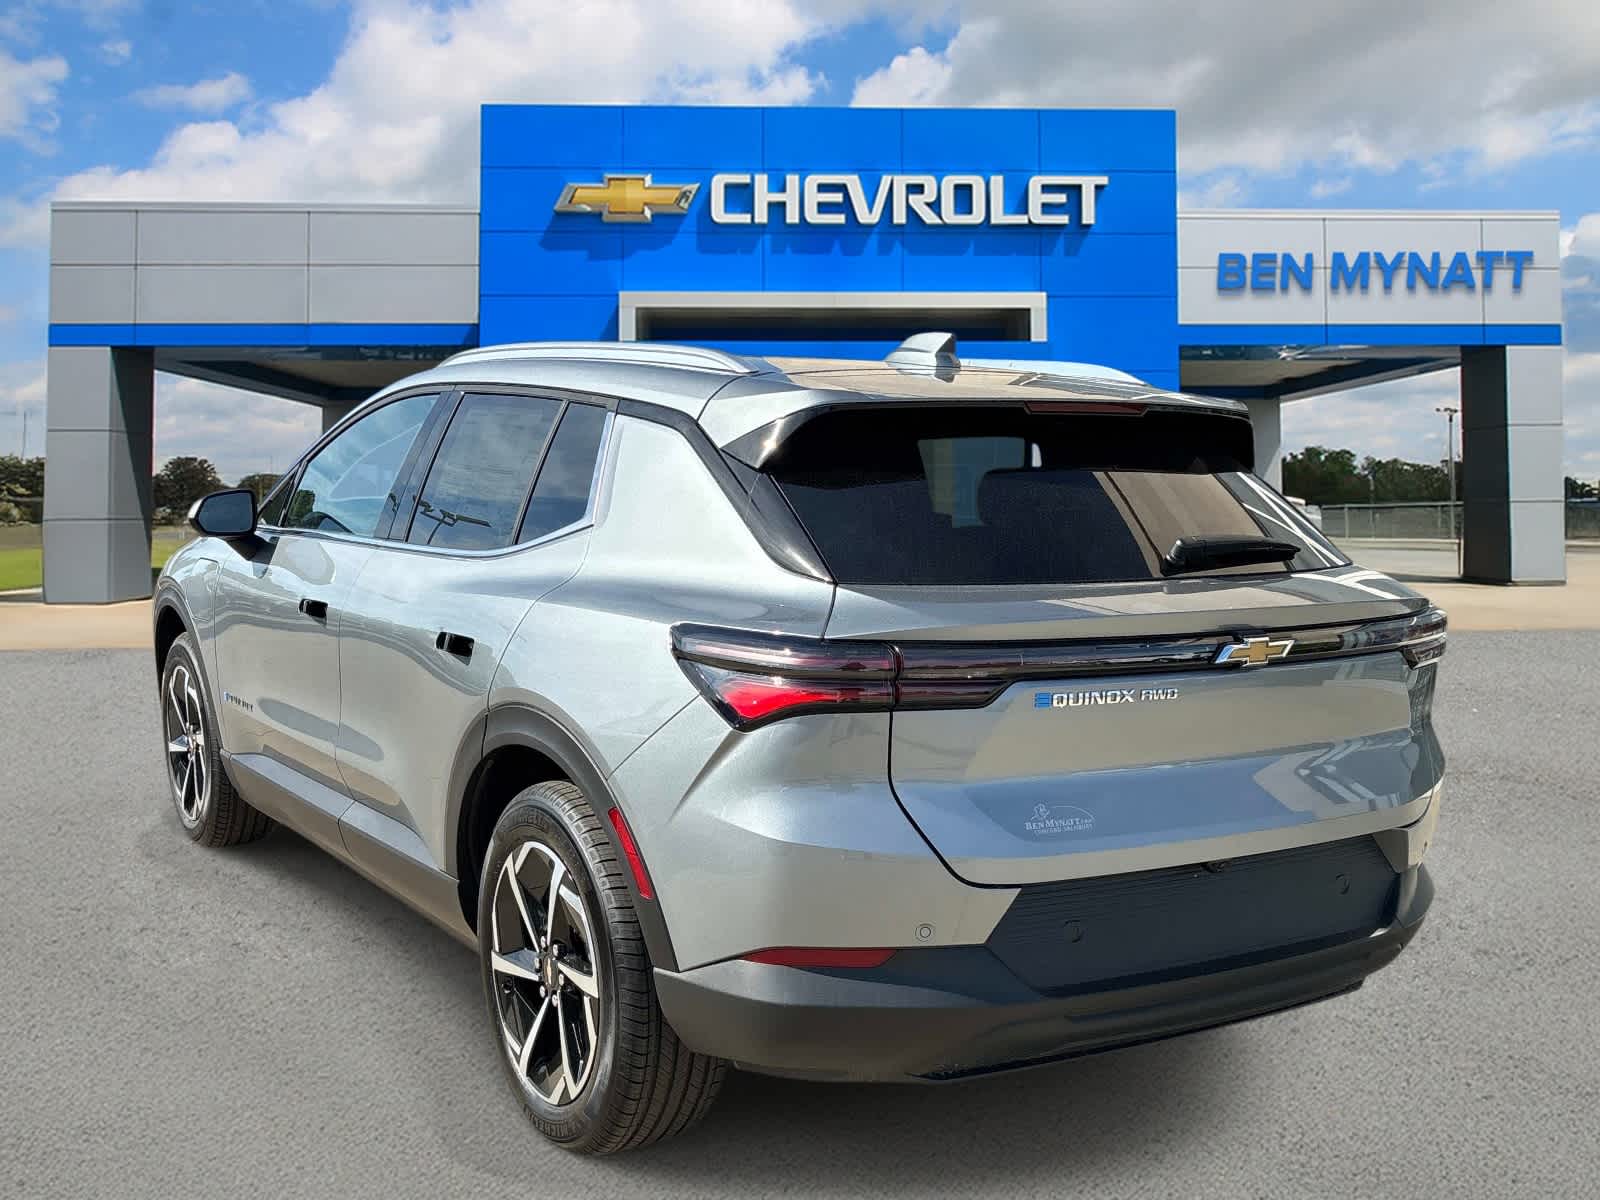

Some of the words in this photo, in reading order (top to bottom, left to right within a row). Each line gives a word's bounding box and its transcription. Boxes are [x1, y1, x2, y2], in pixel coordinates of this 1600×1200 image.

[710, 174, 1109, 225] CHEVROLET
[1216, 252, 1314, 290] BEN
[1330, 250, 1535, 290] MYNATT
[1034, 688, 1137, 709] EQUINOX
